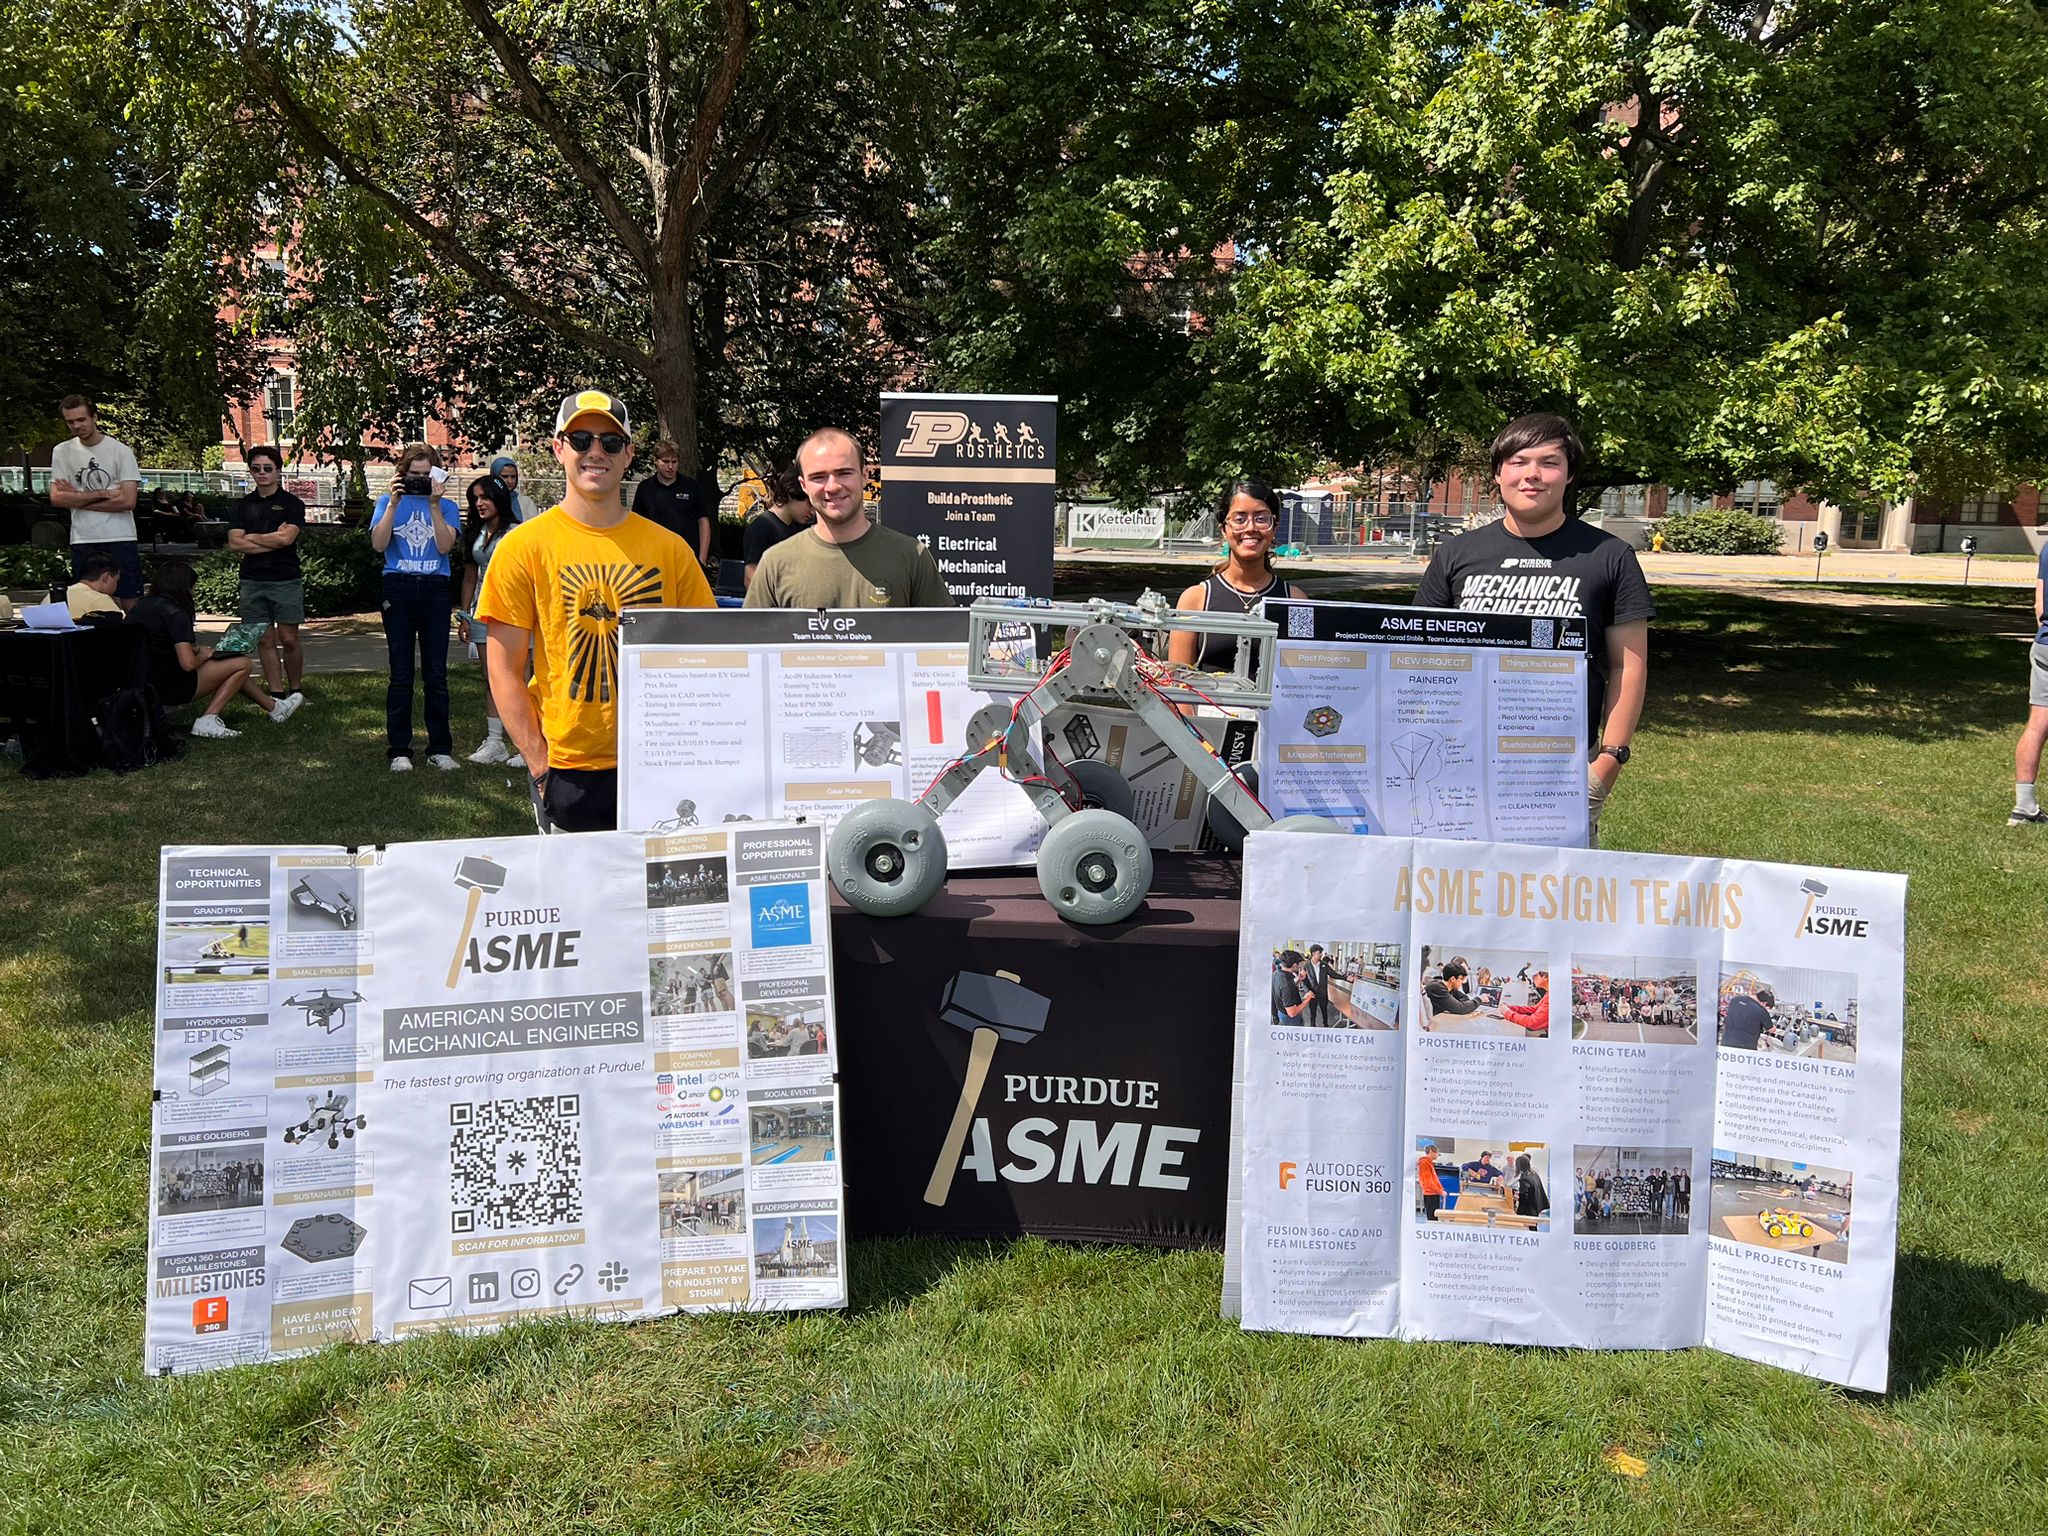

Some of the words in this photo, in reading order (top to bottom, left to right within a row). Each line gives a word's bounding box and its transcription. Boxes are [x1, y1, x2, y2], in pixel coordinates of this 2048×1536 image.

[928, 492, 953, 505] Build
[954, 495, 959, 504] a
[961, 494, 1013, 505] Prosthetic
[945, 511, 964, 521] Join
[965, 513, 970, 521] a
[971, 511, 995, 521] Team
[1098, 514, 1156, 524] Kettelhut
[938, 537, 997, 551] Electrical
[423, 560, 439, 570] IEEE
[938, 560, 1006, 574] Mechanical
[945, 583, 1025, 597] anufacturing
[1461, 575, 1580, 601] MECHANICAL
[1459, 597, 1582, 617] ENGINEERING
[808, 618, 828, 631] EV
[833, 618, 856, 631] GP
[1381, 618, 1423, 630] ASME
[1426, 620, 1486, 633] ENERGY
[1560, 638, 1584, 646] ASME
[1319, 655, 1350, 663] Projects
[1423, 658, 1466, 667] PROJECT
[1409, 676, 1458, 685] RAINERGY
[1288, 751, 1318, 759] Mission
[743, 838, 812, 850] PROFESSIONAL
[742, 849, 813, 861] OPPORTUNITIES
[188, 867, 250, 878] TECHNICAL
[750, 874, 769, 882] ASME
[770, 872, 806, 880] NATIONALS
[175, 878, 262, 889] OPPORTUNITIES
[1393, 866, 1484, 916] ASME
[1497, 870, 1616, 924] DESIGN
[1630, 879, 1743, 930] TEAMS
[193, 907, 224, 916] GRAND
[226, 906, 244, 914] PRIX
[758, 904, 804, 922] ASME
[1815, 906, 1858, 917] PURDUE
[485, 908, 560, 927] PURDUE
[1804, 916, 1869, 939] ASME
[464, 930, 581, 974] ASME
[666, 941, 714, 951] CONFERENCES
[759, 979, 809, 988] PROFESSIONAL
[760, 988, 809, 996] DEVELOPMENT
[400, 1008, 504, 1030] AMERICAN
[510, 1001, 595, 1022] SOCIETY
[601, 999, 627, 1015] OF
[186, 1016, 247, 1028] HYDROPONICS
[184, 1028, 244, 1044] EPICS
[389, 1030, 521, 1055] MECHANICAL
[527, 1022, 639, 1045] ENGINEERS
[1270, 1031, 1342, 1045] CONSULTING
[1345, 1035, 1374, 1046] TEAM
[1419, 1038, 1496, 1050] PROSTHETICS
[1498, 1041, 1526, 1052] TEAM
[1572, 1046, 1614, 1057] RACING
[1617, 1048, 1646, 1058] TEAM
[1716, 1052, 1772, 1068] ROBOTICS
[1775, 1059, 1820, 1074] DESIGN
[1823, 1066, 1855, 1079] TEAM
[305, 1074, 346, 1084] ROBOTICS
[384, 1079, 405, 1090] The
[410, 1074, 450, 1088] fastest
[455, 1071, 503, 1087] growing
[507, 1065, 580, 1082] organization
[583, 1064, 595, 1074] at
[599, 1060, 645, 1073] Purdue!
[677, 1074, 702, 1085] intel
[718, 1072, 739, 1080] CMTA
[1489, 1080, 1513, 1088] project
[725, 1087, 739, 1099] bp
[764, 1089, 790, 1097] SOCIAL
[792, 1088, 817, 1096] EVENTS
[1004, 1074, 1159, 1109] PURDUE
[1725, 1092, 1772, 1103] International
[1774, 1097, 1796, 1107] Rover
[1798, 1101, 1835, 1113] Challenge
[1430, 1116, 1458, 1124] hospital
[1460, 1118, 1487, 1126] workers
[1724, 1112, 1766, 1123] competitive
[1769, 1118, 1788, 1126] team
[658, 1121, 703, 1130] WABASH
[178, 1133, 201, 1143] RUBE
[203, 1130, 250, 1141] GOLDBERG
[961, 1117, 1201, 1191] ASME
[1306, 1163, 1382, 1177] AUTODESK
[1306, 1179, 1361, 1193] FUSION
[1365, 1180, 1391, 1193] 360
[756, 1203, 798, 1212] LEADERSHIP
[799, 1201, 834, 1210] AVAILABLE
[1267, 1226, 1308, 1236] FUSION
[1310, 1227, 1329, 1237] 360
[1338, 1227, 1359, 1238] CAD
[1361, 1228, 1382, 1238] AND
[458, 1242, 485, 1252] SCAN
[488, 1239, 509, 1249] FOR
[511, 1232, 580, 1248] INFORMATION!
[786, 1239, 813, 1249] ASME
[1267, 1238, 1287, 1248] FEA
[1289, 1239, 1356, 1250] MILESTONES
[1416, 1230, 1505, 1245] SUSTAINABILITY
[1508, 1235, 1540, 1247] TEAM
[1574, 1241, 1602, 1251] RUBE
[1604, 1241, 1656, 1251] GOLDBERG
[164, 1255, 197, 1267] FUSION
[198, 1253, 213, 1263] 360
[222, 1251, 239, 1261] CAD
[240, 1249, 258, 1259] AND
[1708, 1242, 1742, 1258] SMALL
[1745, 1250, 1807, 1272] PROJECTS
[1810, 1263, 1843, 1280] TEAM
[176, 1263, 192, 1273] FEA
[193, 1259, 247, 1272] MILESTONES
[664, 1267, 705, 1276] PREPARE
[707, 1266, 720, 1274] TO
[722, 1264, 747, 1273] TAKE
[156, 1268, 265, 1299] MILESTONES
[668, 1280, 682, 1288] ON
[684, 1277, 728, 1287] INDUSTRY
[731, 1276, 744, 1284] BY
[1718, 1273, 1734, 1283] team
[1736, 1278, 1780, 1294] opportunity
[688, 1288, 724, 1298] STORM!
[1717, 1293, 1736, 1304] board
[1738, 1298, 1745, 1306] to
[1747, 1300, 1761, 1309] real
[1763, 1304, 1775, 1313] life
[283, 1312, 311, 1325] HAVE
[313, 1310, 329, 1320] AN
[332, 1306, 362, 1317] IDEA?
[204, 1323, 221, 1332] 360
[285, 1326, 305, 1336] LET
[307, 1324, 321, 1333] US
[324, 1319, 360, 1330] KNOW!
